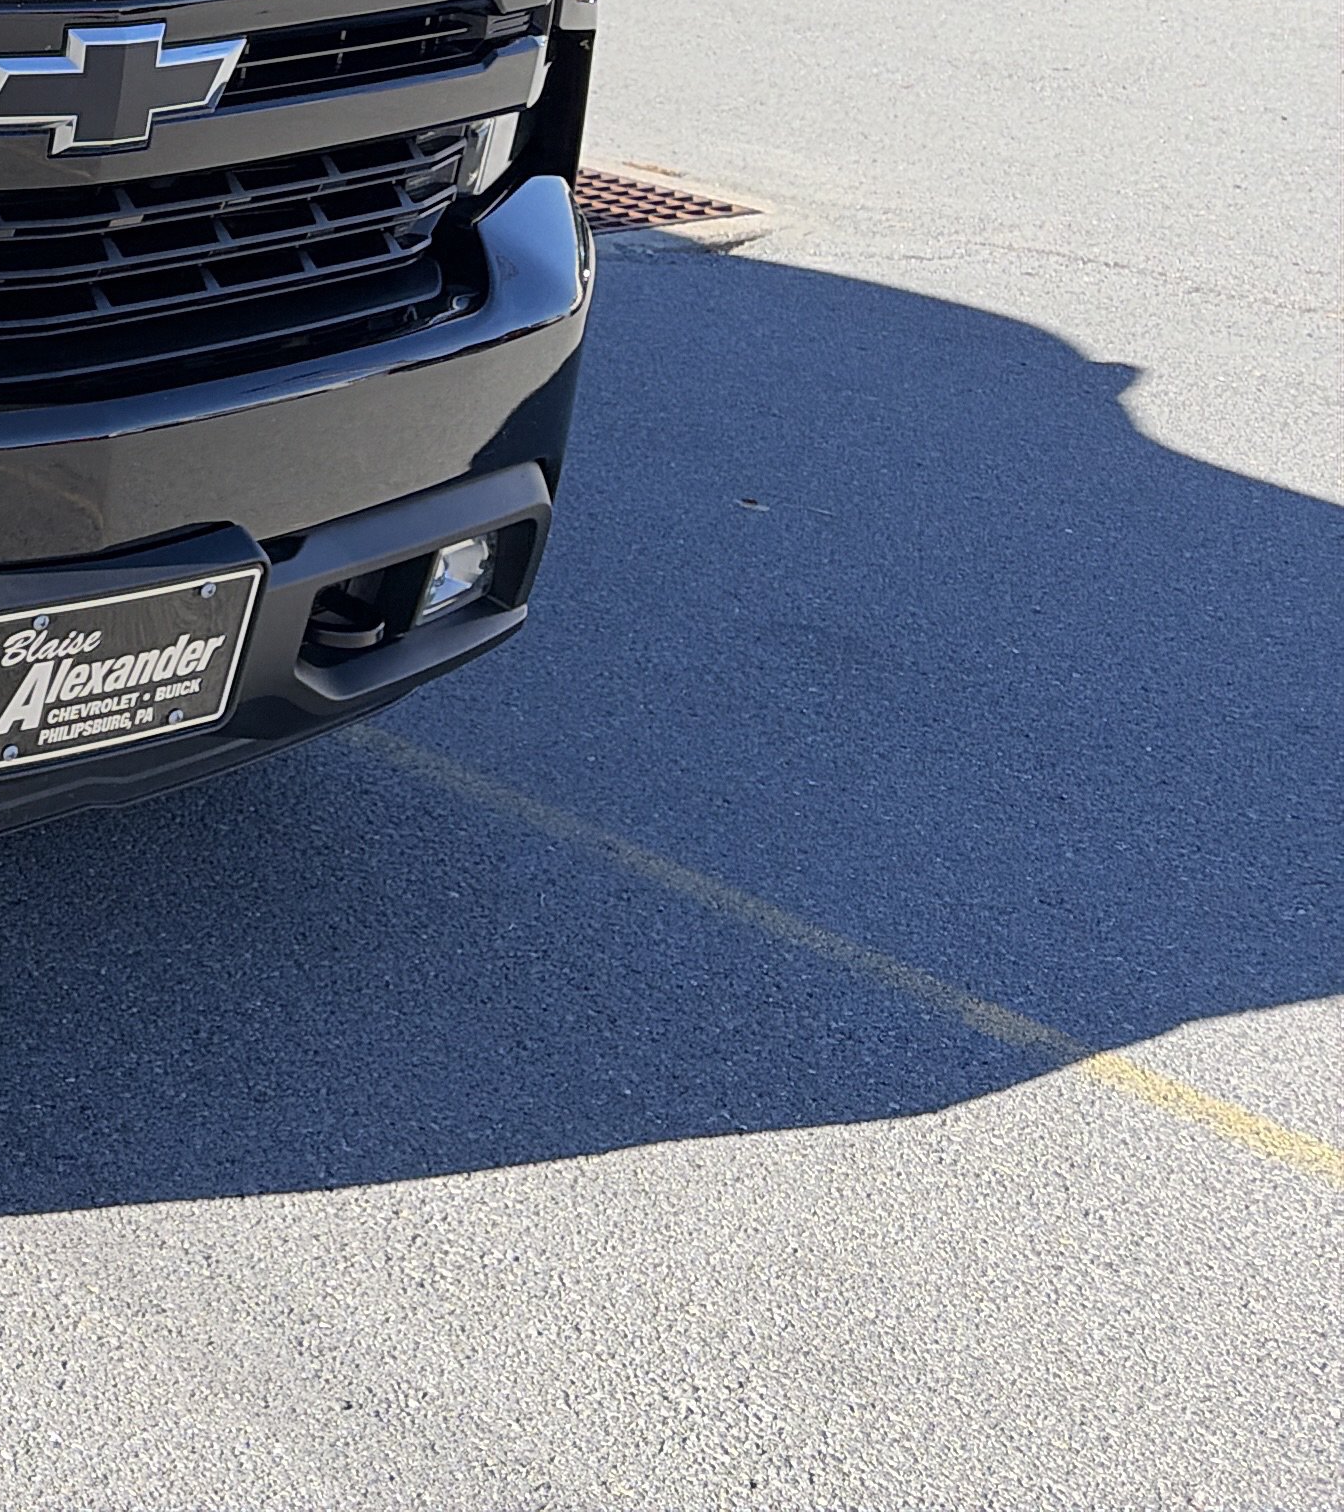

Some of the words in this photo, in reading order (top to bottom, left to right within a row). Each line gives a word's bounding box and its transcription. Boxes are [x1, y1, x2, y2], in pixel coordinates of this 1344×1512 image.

[0, 629, 102, 667] Blaise
[46, 692, 140, 725] CHEVROLET
[153, 677, 203, 703] BUICK
[37, 712, 132, 746] PHILIPSBURG,
[134, 706, 154, 726] PA
